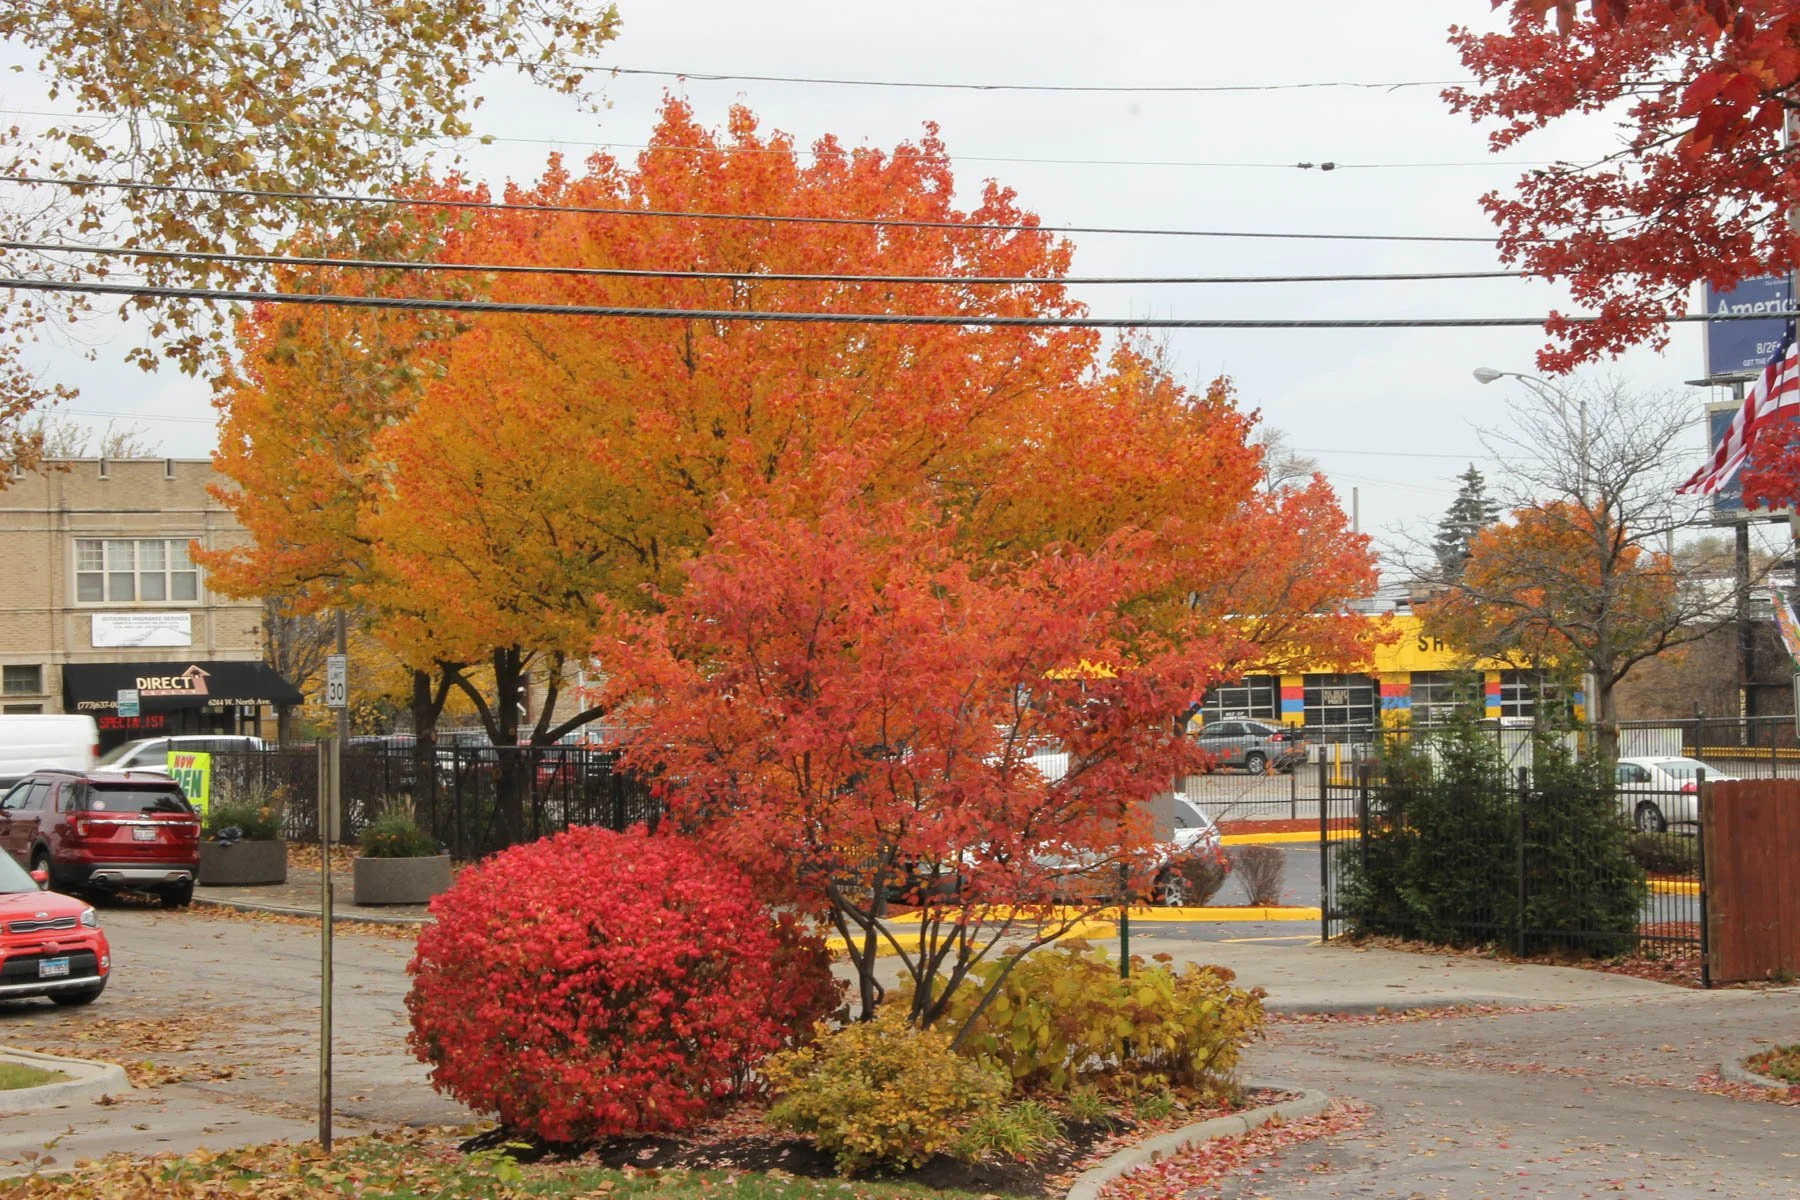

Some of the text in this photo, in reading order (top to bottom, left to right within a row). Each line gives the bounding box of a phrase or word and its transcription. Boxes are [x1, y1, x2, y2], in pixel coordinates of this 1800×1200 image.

[136, 676, 192, 690] DIRECT
[330, 683, 344, 700] 30
[99, 715, 165, 729] SPECIAIST
[174, 755, 195, 769] NOW
